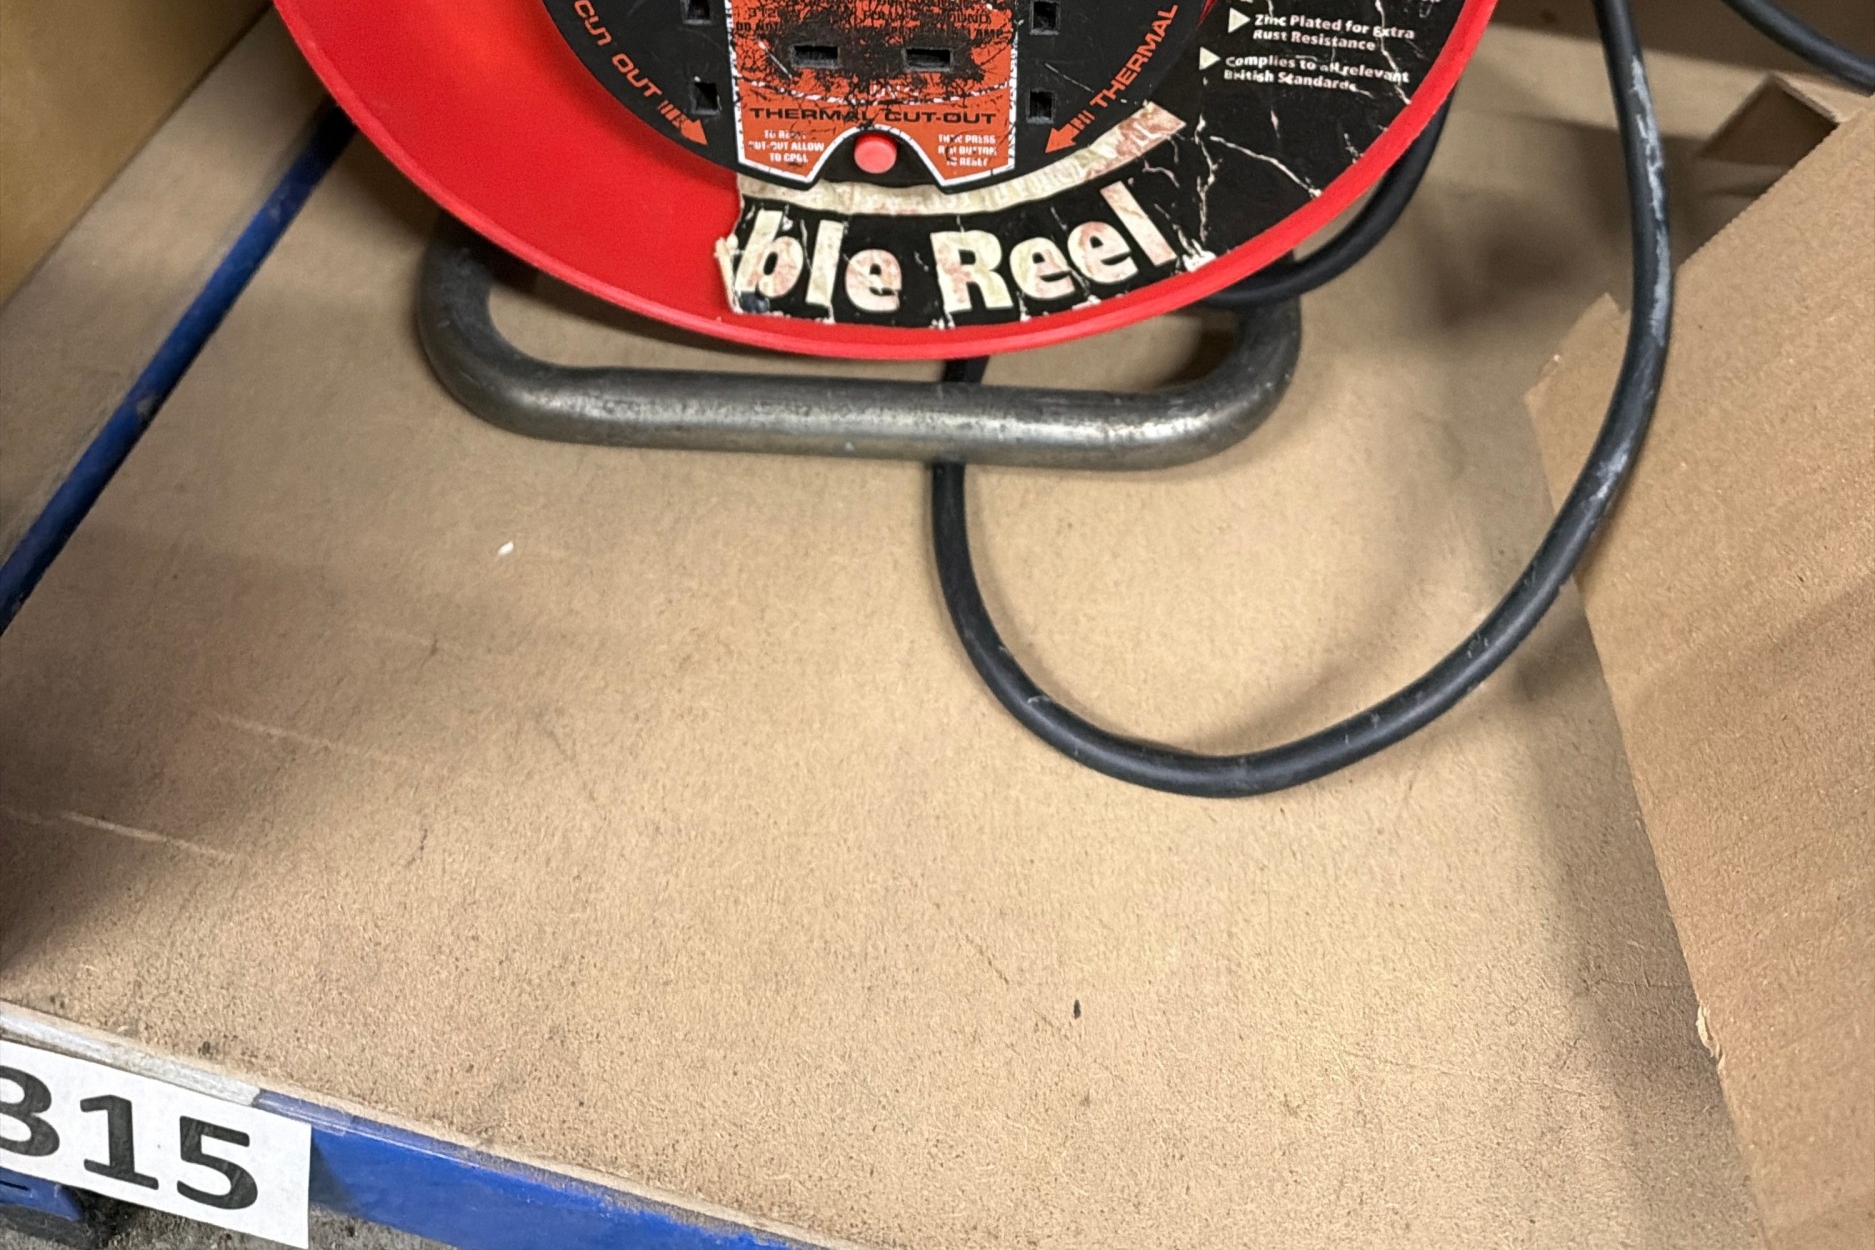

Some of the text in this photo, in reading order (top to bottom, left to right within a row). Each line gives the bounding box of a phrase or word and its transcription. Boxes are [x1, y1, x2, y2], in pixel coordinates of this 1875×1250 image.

[1253, 29, 1376, 51] Rust Resistance
[1254, 14, 1416, 40] Zinc Plated for Extra
[574, 0, 613, 46] CUT
[611, 53, 662, 98] OUT
[1090, 4, 1178, 117] THERMAL
[1224, 69, 1357, 91] British Standards
[1225, 55, 1296, 69] Complies
[1299, 60, 1317, 71] to
[1341, 64, 1411, 83] relevant
[749, 107, 997, 124] THERMAL CUT-OUT
[769, 152, 782, 162] TO
[791, 141, 825, 151] ALLOW
[734, 180, 1177, 314] ble Reel
[0, 1065, 258, 1210] 315
